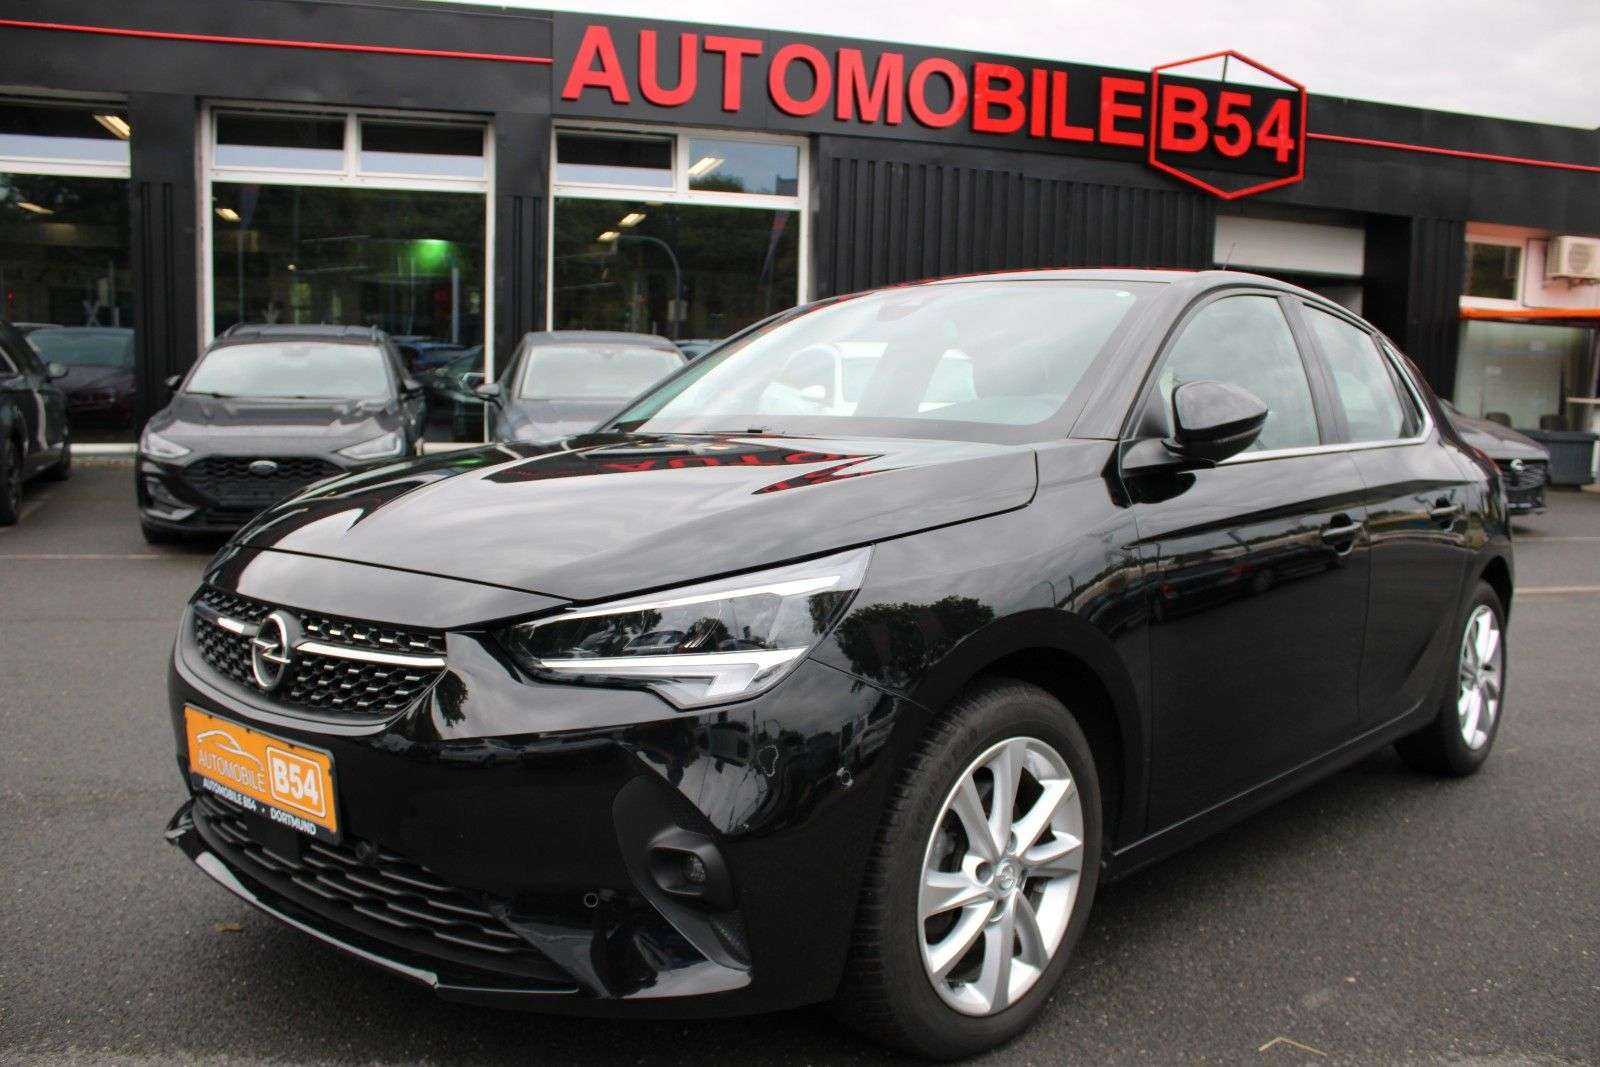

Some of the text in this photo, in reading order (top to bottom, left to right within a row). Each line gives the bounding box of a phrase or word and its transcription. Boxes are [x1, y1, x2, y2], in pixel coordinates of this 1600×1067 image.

[562, 25, 1295, 163] AUTOMOBILE B54
[198, 750, 265, 793] AUTOMOBILE
[272, 757, 319, 806] B54
[270, 807, 317, 835] DORTMUND
